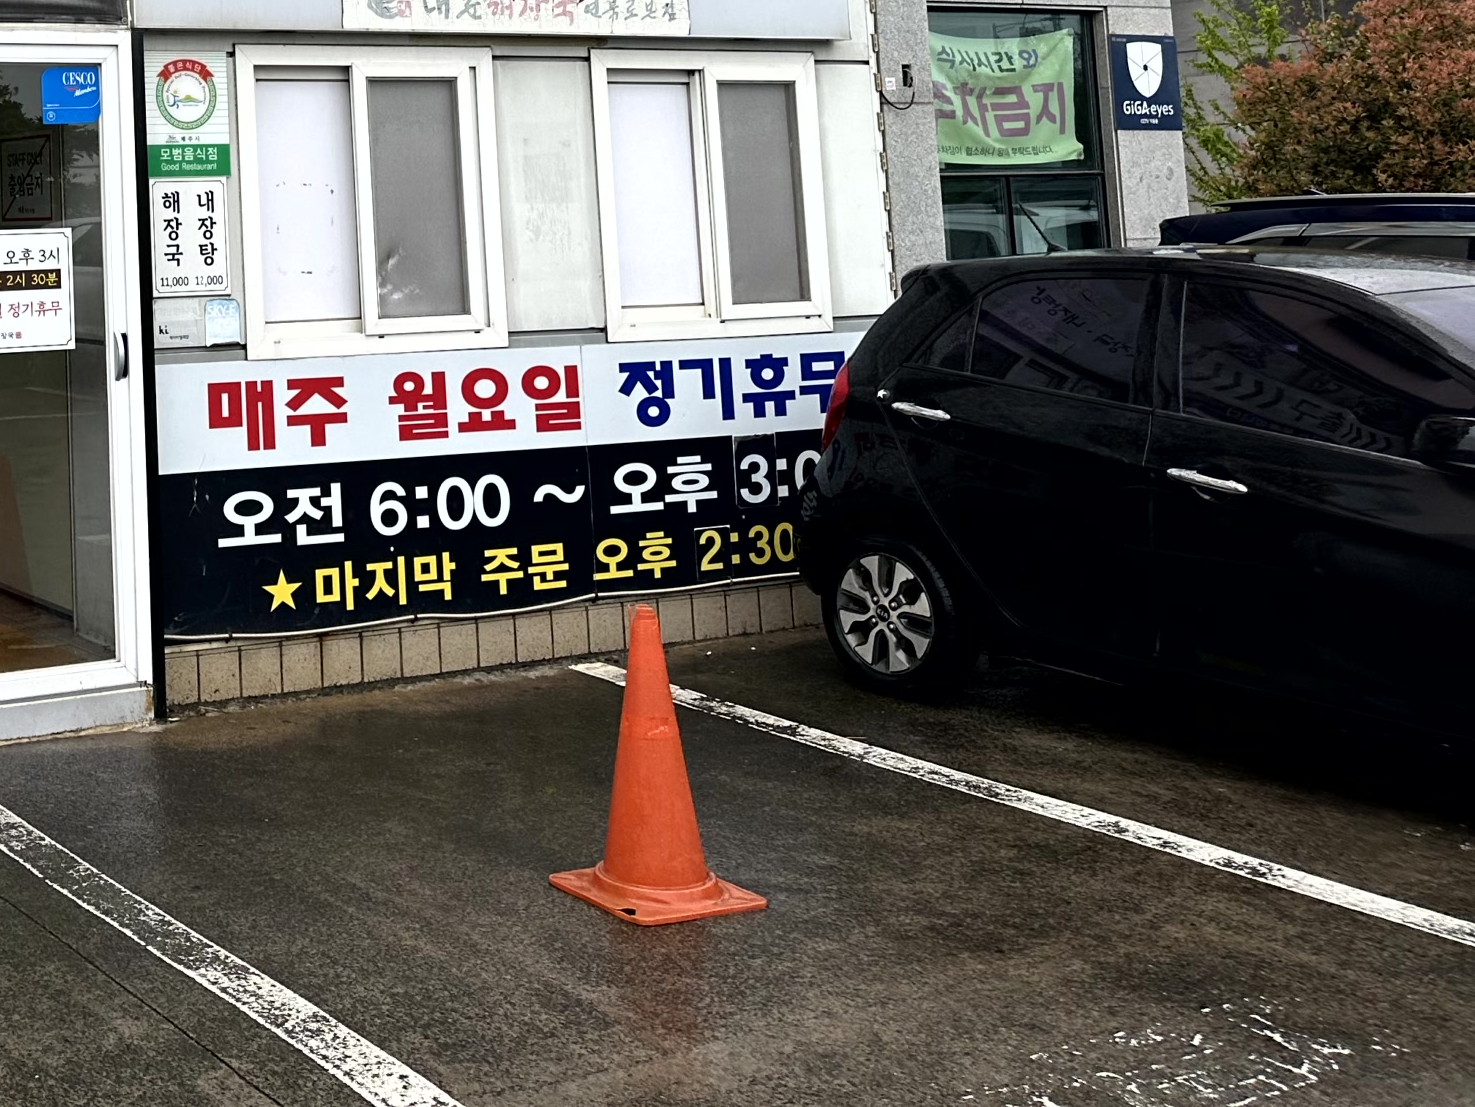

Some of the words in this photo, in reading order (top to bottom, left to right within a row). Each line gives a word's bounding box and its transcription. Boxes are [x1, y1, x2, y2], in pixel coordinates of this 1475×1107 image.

[937, 45, 1016, 73] 식사시간
[62, 71, 95, 85] CESCO
[160, 146, 218, 161] 모범음식점
[161, 162, 179, 171] Good
[181, 162, 217, 171] Restaurant
[162, 190, 184, 267] 해장국
[196, 189, 218, 266] 내장탕
[3, 248, 34, 267] 오후
[38, 247, 60, 265] 3시
[6, 273, 26, 287] 2시
[31, 272, 58, 286] 30분
[160, 276, 189, 287] 11,000
[7, 300, 63, 318] 정기휴무
[207, 376, 349, 453] 매주
[388, 365, 582, 442] 월요일
[618, 351, 846, 429] 정기휴무
[217, 483, 346, 549] 오전
[369, 474, 509, 537] 6:00
[610, 455, 718, 514] 오후
[315, 551, 456, 611] 마지막
[481, 543, 570, 593] 주문
[594, 532, 678, 580] 오후
[699, 522, 795, 571] 2:30
